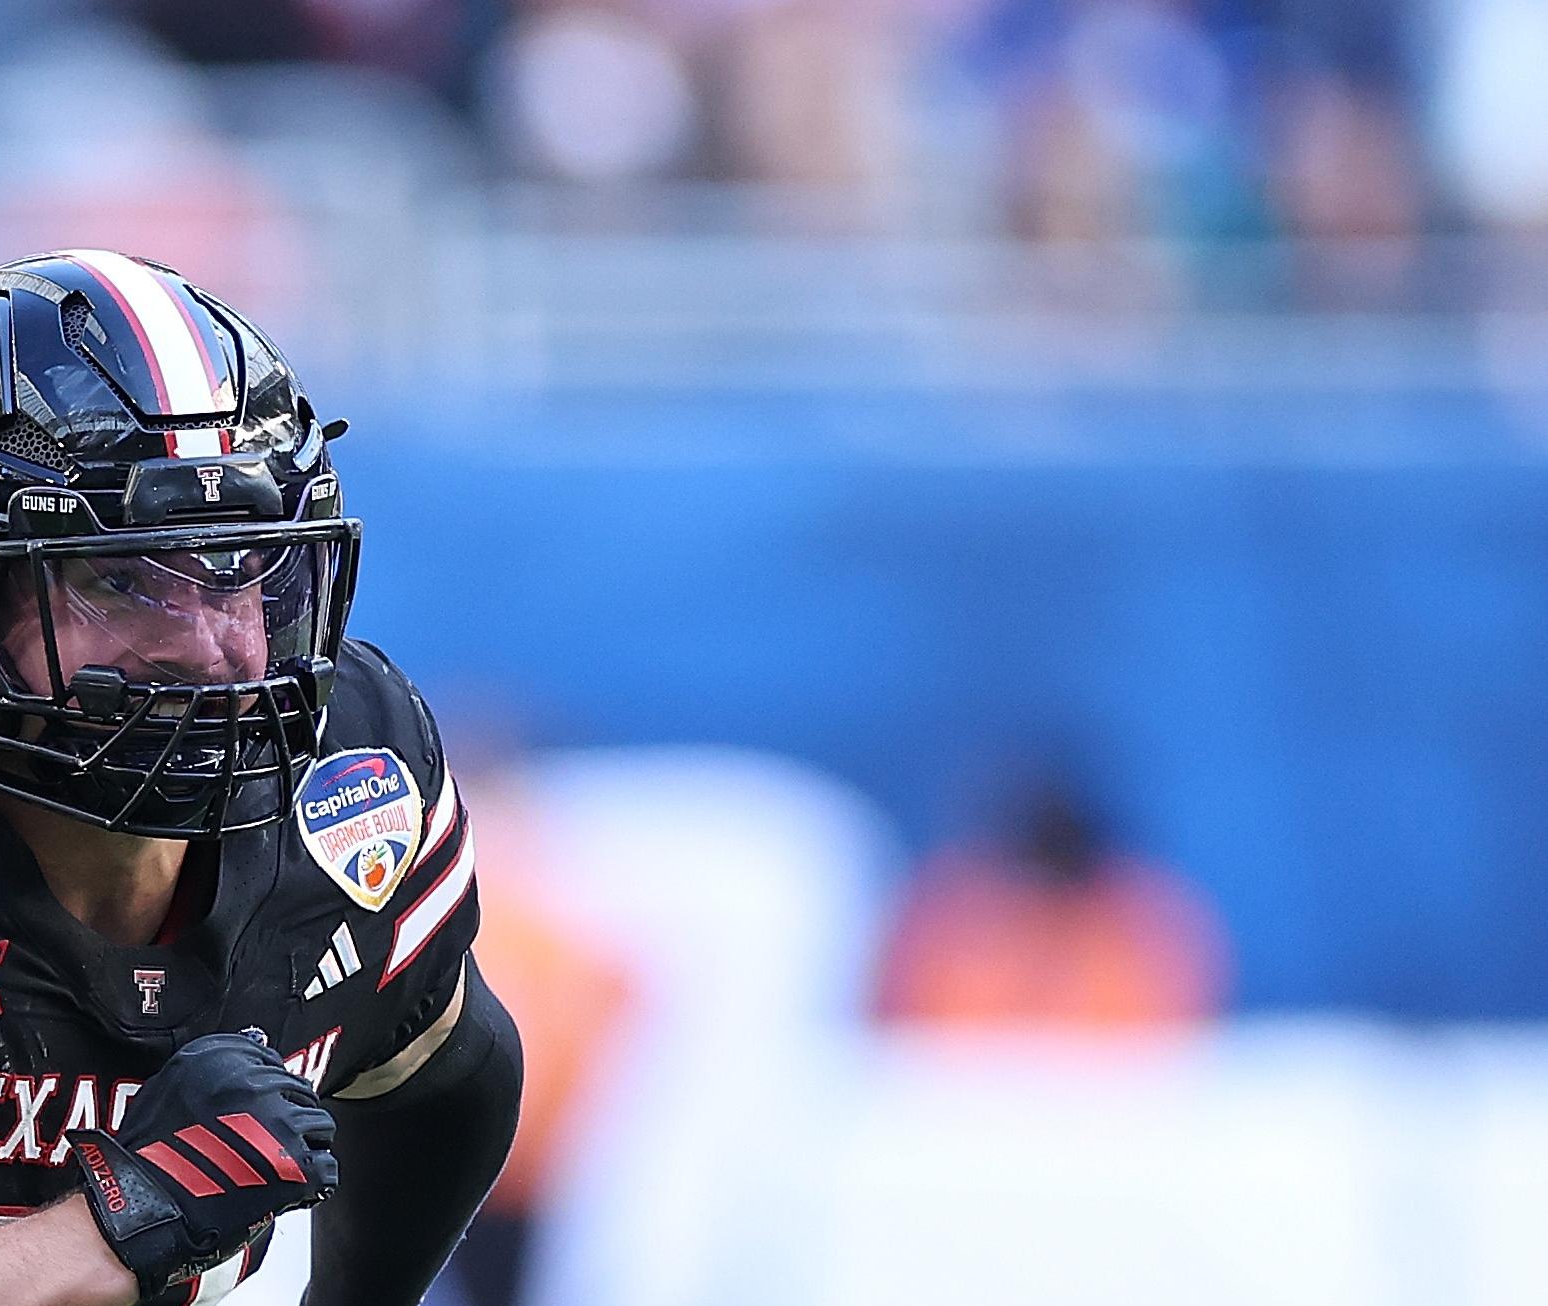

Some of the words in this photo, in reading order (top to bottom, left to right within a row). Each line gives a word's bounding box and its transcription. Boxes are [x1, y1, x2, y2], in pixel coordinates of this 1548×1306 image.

[22, 495, 57, 513] GUNS
[59, 497, 78, 514] UP
[317, 817, 374, 863] ORANGE
[372, 803, 413, 835] BOWL
[78, 1142, 128, 1213] ADIZERO
